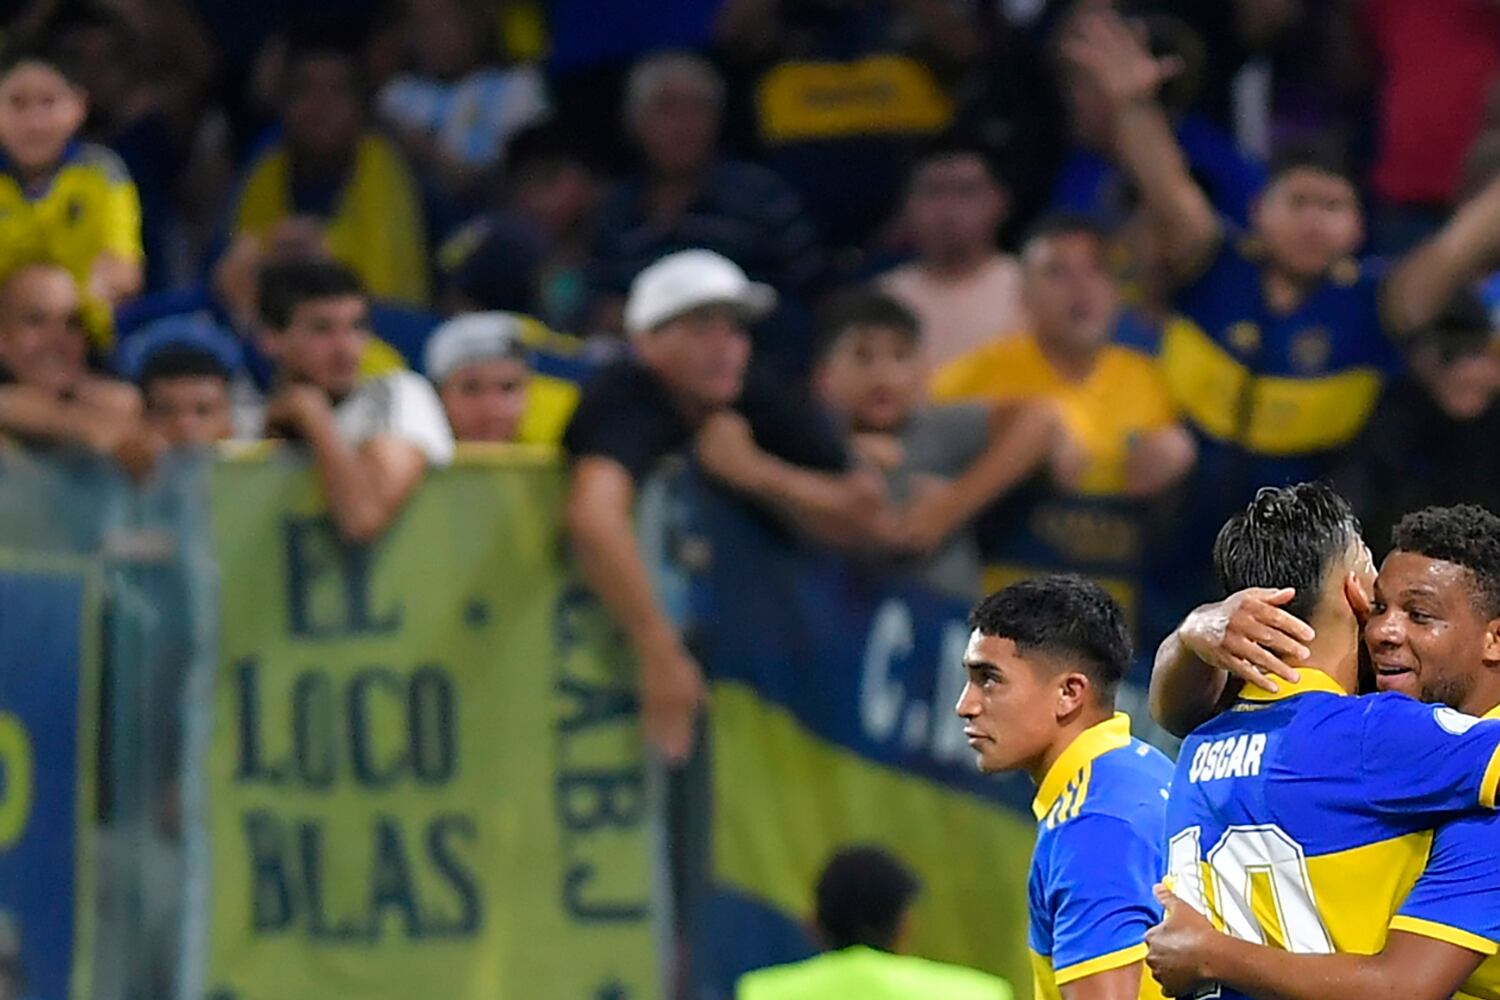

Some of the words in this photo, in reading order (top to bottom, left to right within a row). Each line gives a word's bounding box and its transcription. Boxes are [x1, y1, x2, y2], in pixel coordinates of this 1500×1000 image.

[286, 514, 399, 641] EL
[234, 655, 456, 787] LOCO
[1189, 733, 1266, 784] OSCAR
[244, 812, 481, 940] BLAS
